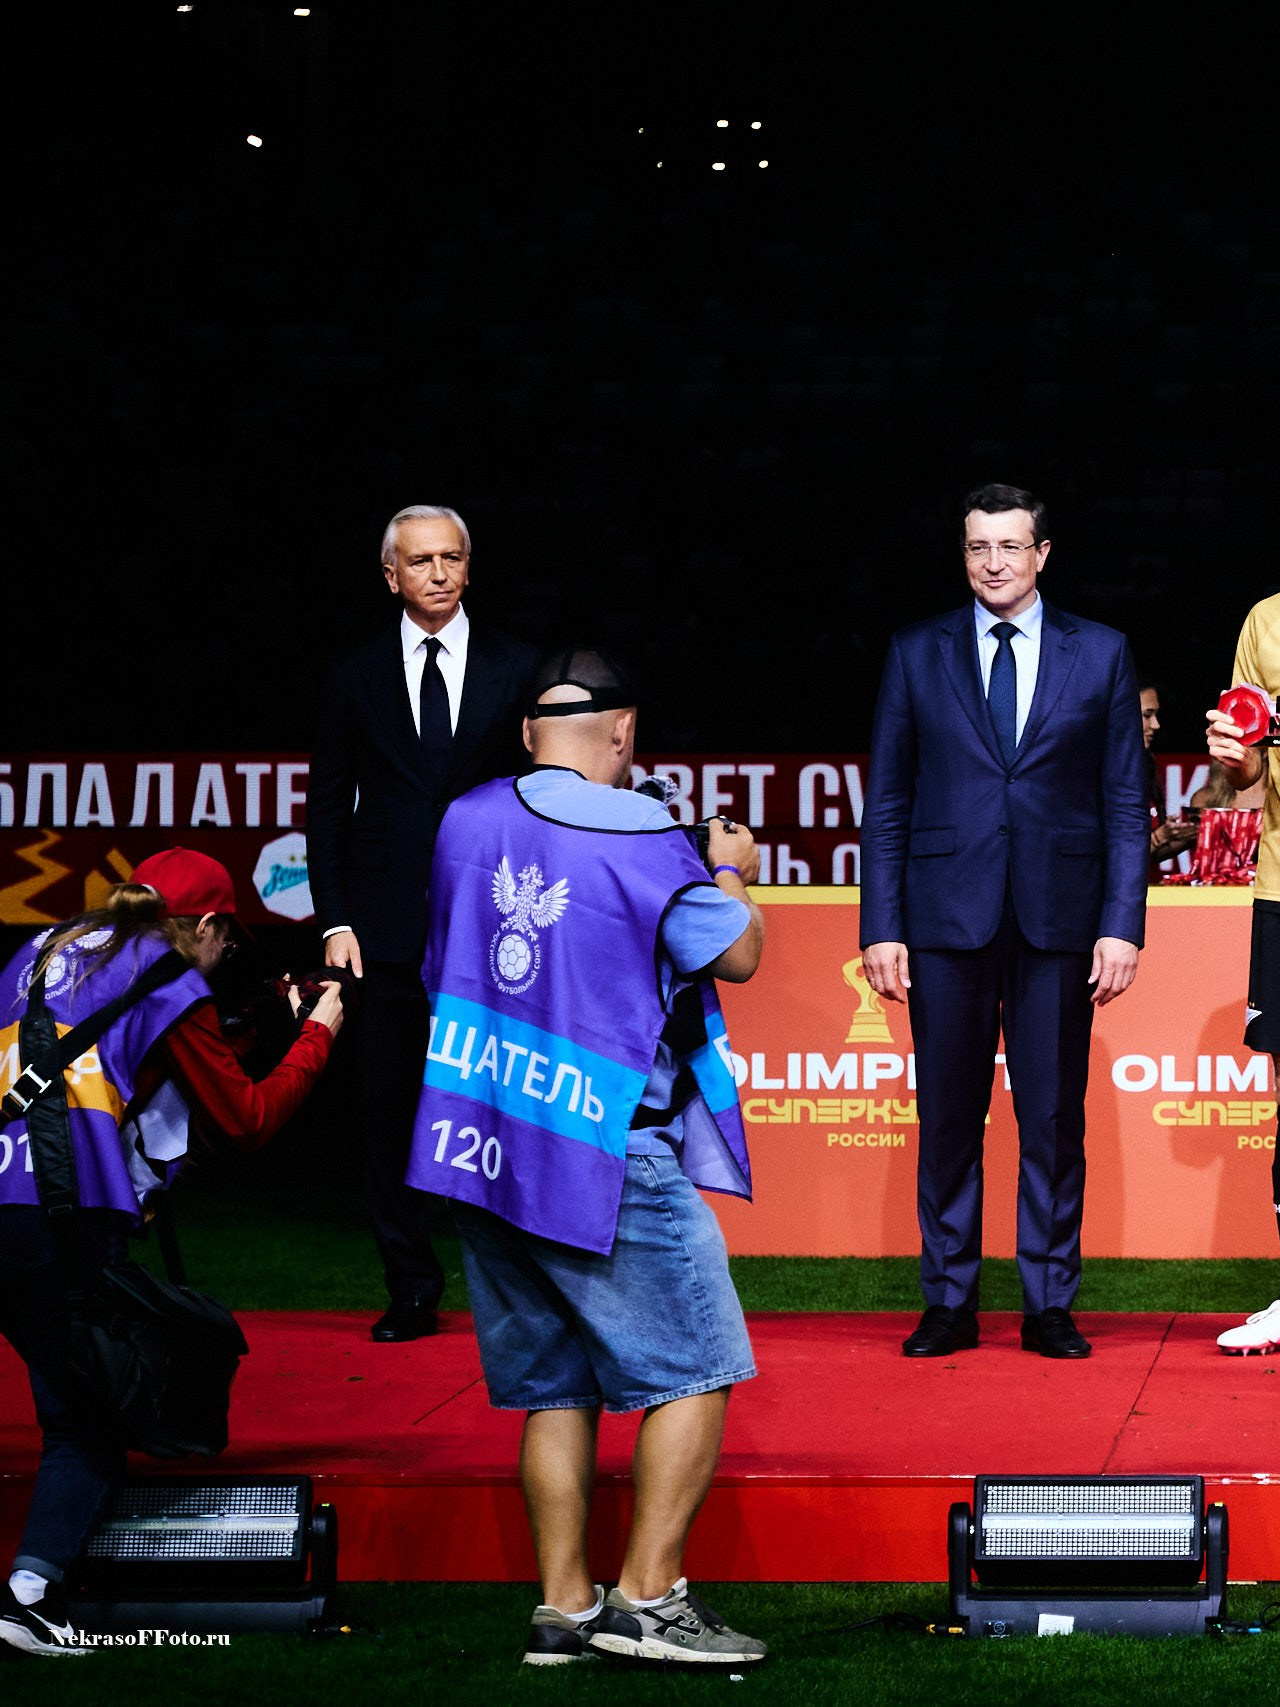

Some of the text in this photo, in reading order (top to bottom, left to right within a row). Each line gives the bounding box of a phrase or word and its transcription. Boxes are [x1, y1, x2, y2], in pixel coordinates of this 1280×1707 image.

[426, 1015, 605, 1123] ЩАТЕЛЬ
[431, 1119, 502, 1180] 120
[827, 1132, 906, 1148] РОССИИ
